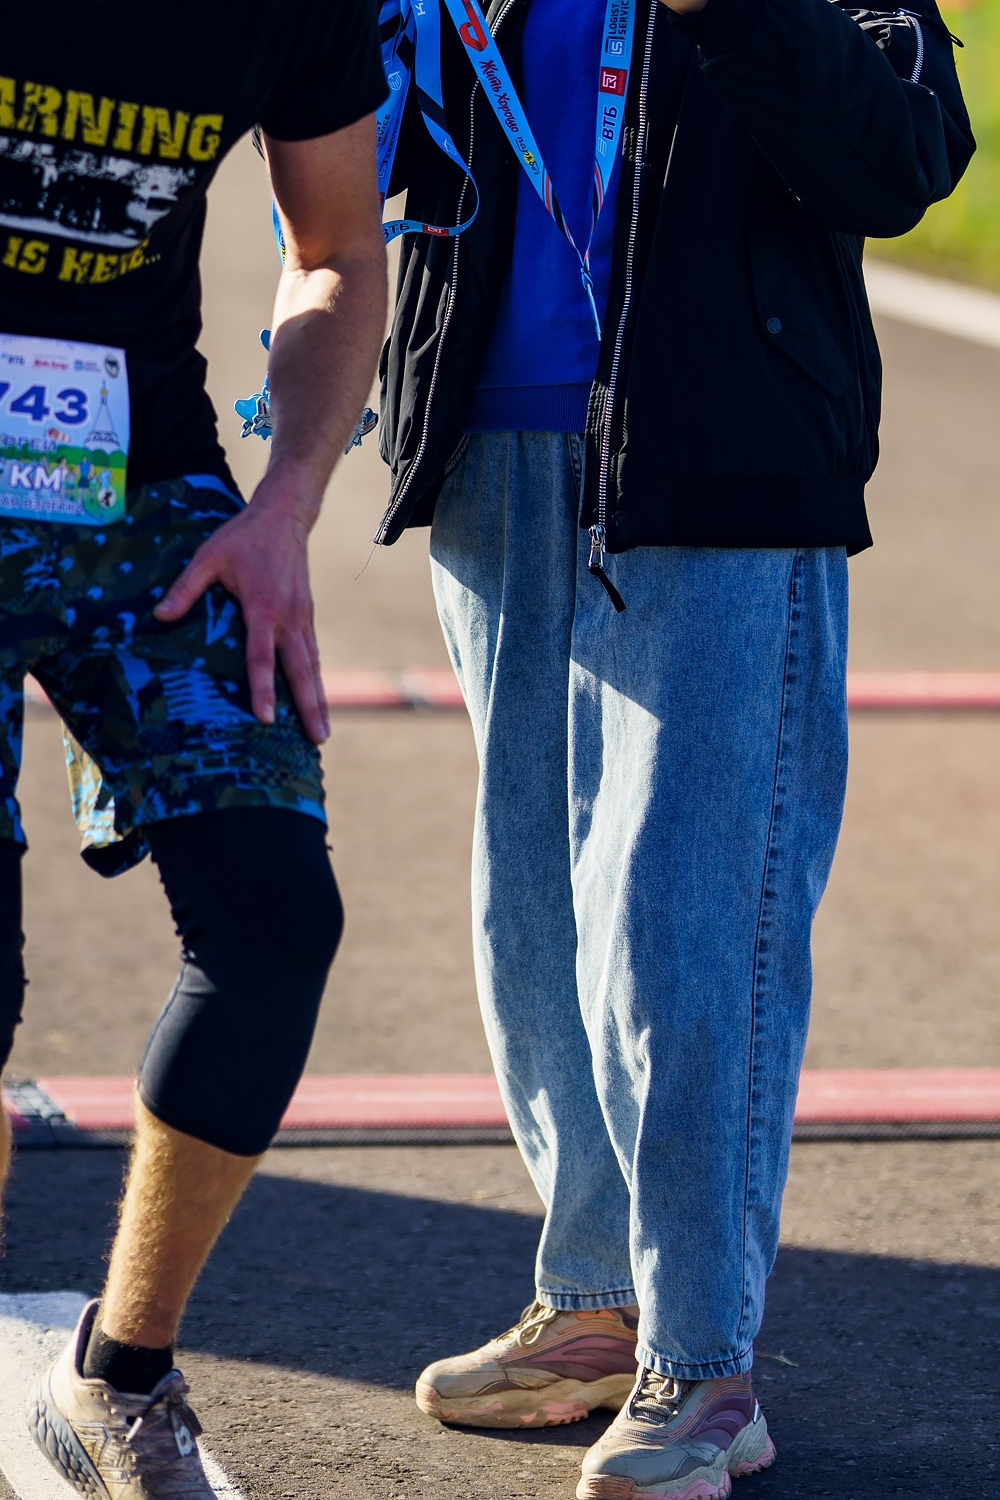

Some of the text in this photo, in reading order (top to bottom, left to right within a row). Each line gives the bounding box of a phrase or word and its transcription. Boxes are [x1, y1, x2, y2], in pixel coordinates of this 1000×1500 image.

[608, 3, 620, 35] LOGIST
[479, 59, 519, 133] Жить Хорошо
[602, 105, 618, 141] ВТБ
[2, 236, 50, 275] IS
[10, 464, 63, 492] КМ
